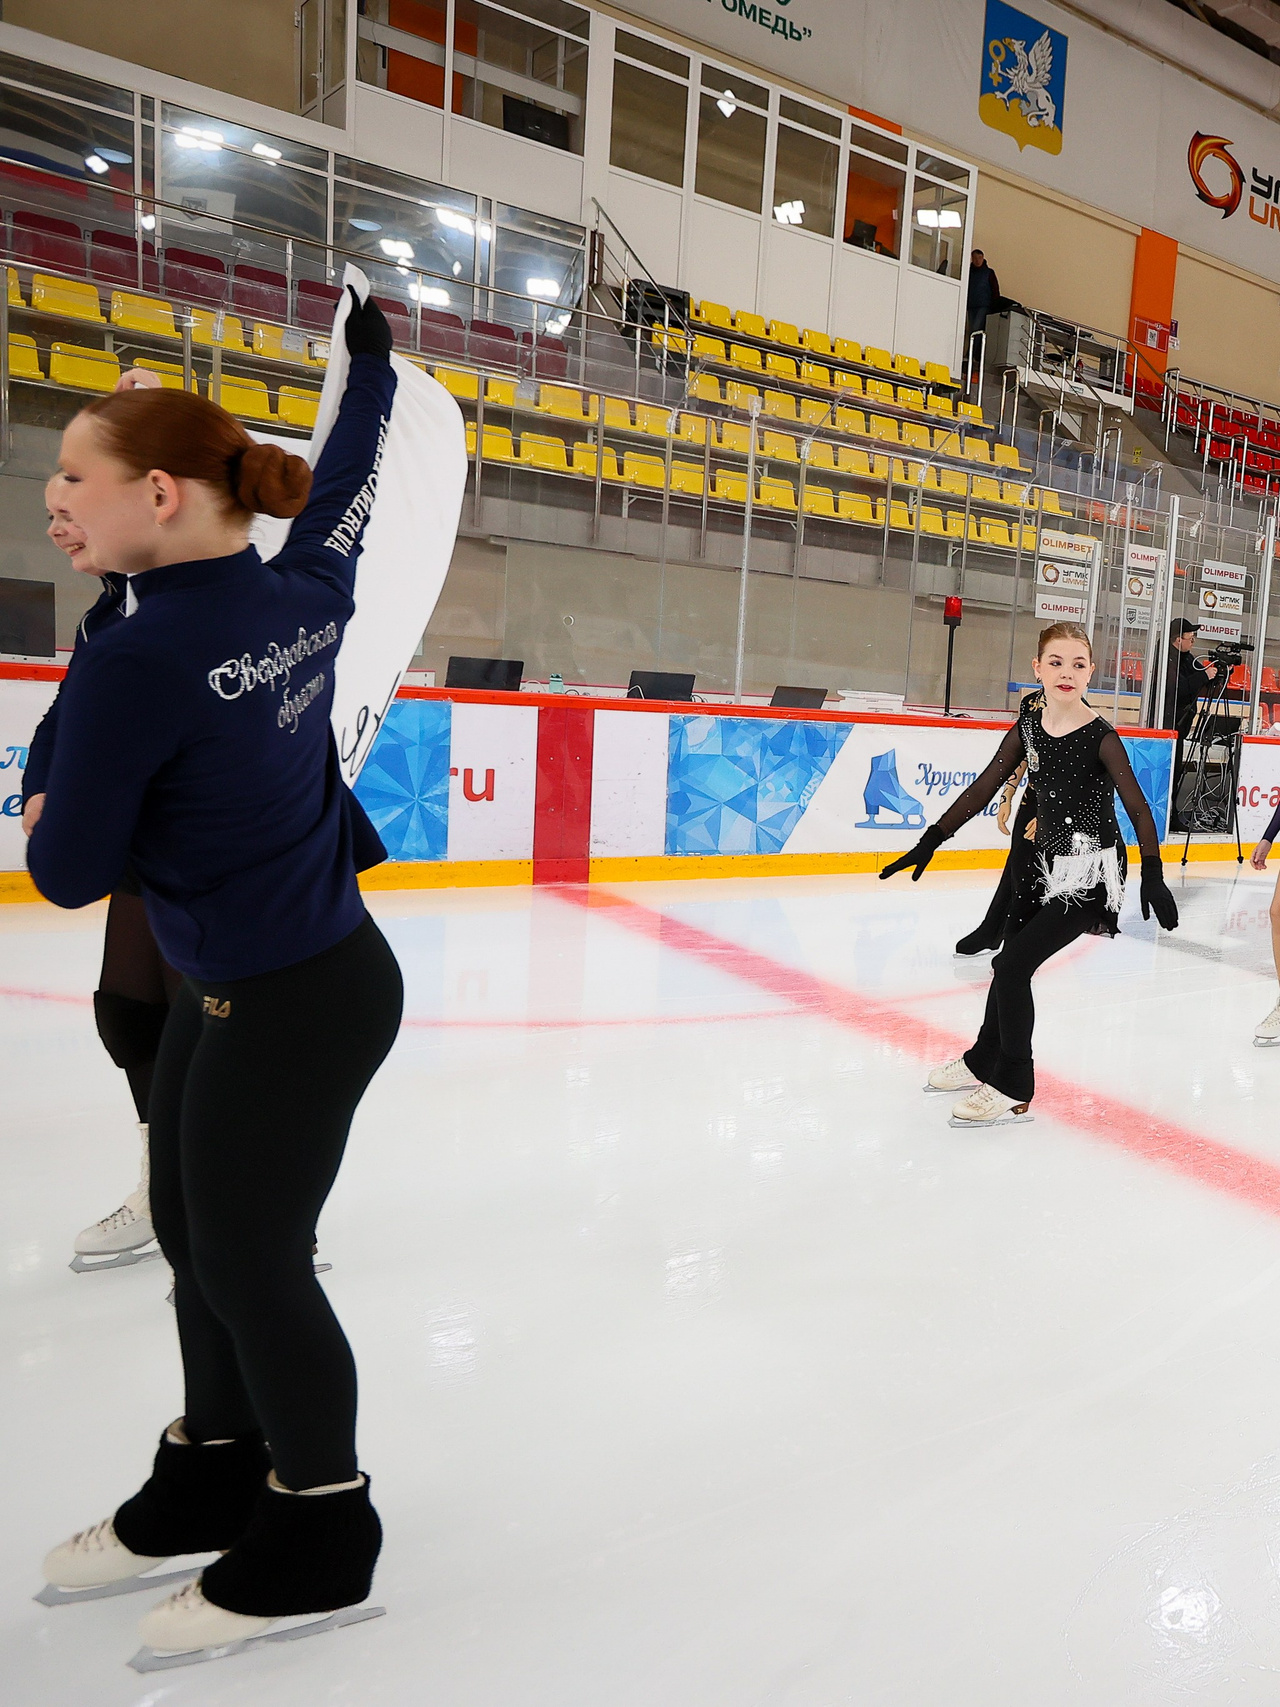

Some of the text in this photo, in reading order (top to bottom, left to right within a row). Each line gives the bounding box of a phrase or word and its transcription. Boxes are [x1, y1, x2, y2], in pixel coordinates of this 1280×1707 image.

[1042, 538, 1093, 553] OLIMPBET
[1203, 567, 1244, 580] OLIMPBET
[1041, 602, 1085, 614] OLIMPBET
[1199, 623, 1240, 636] OLIMPBET
